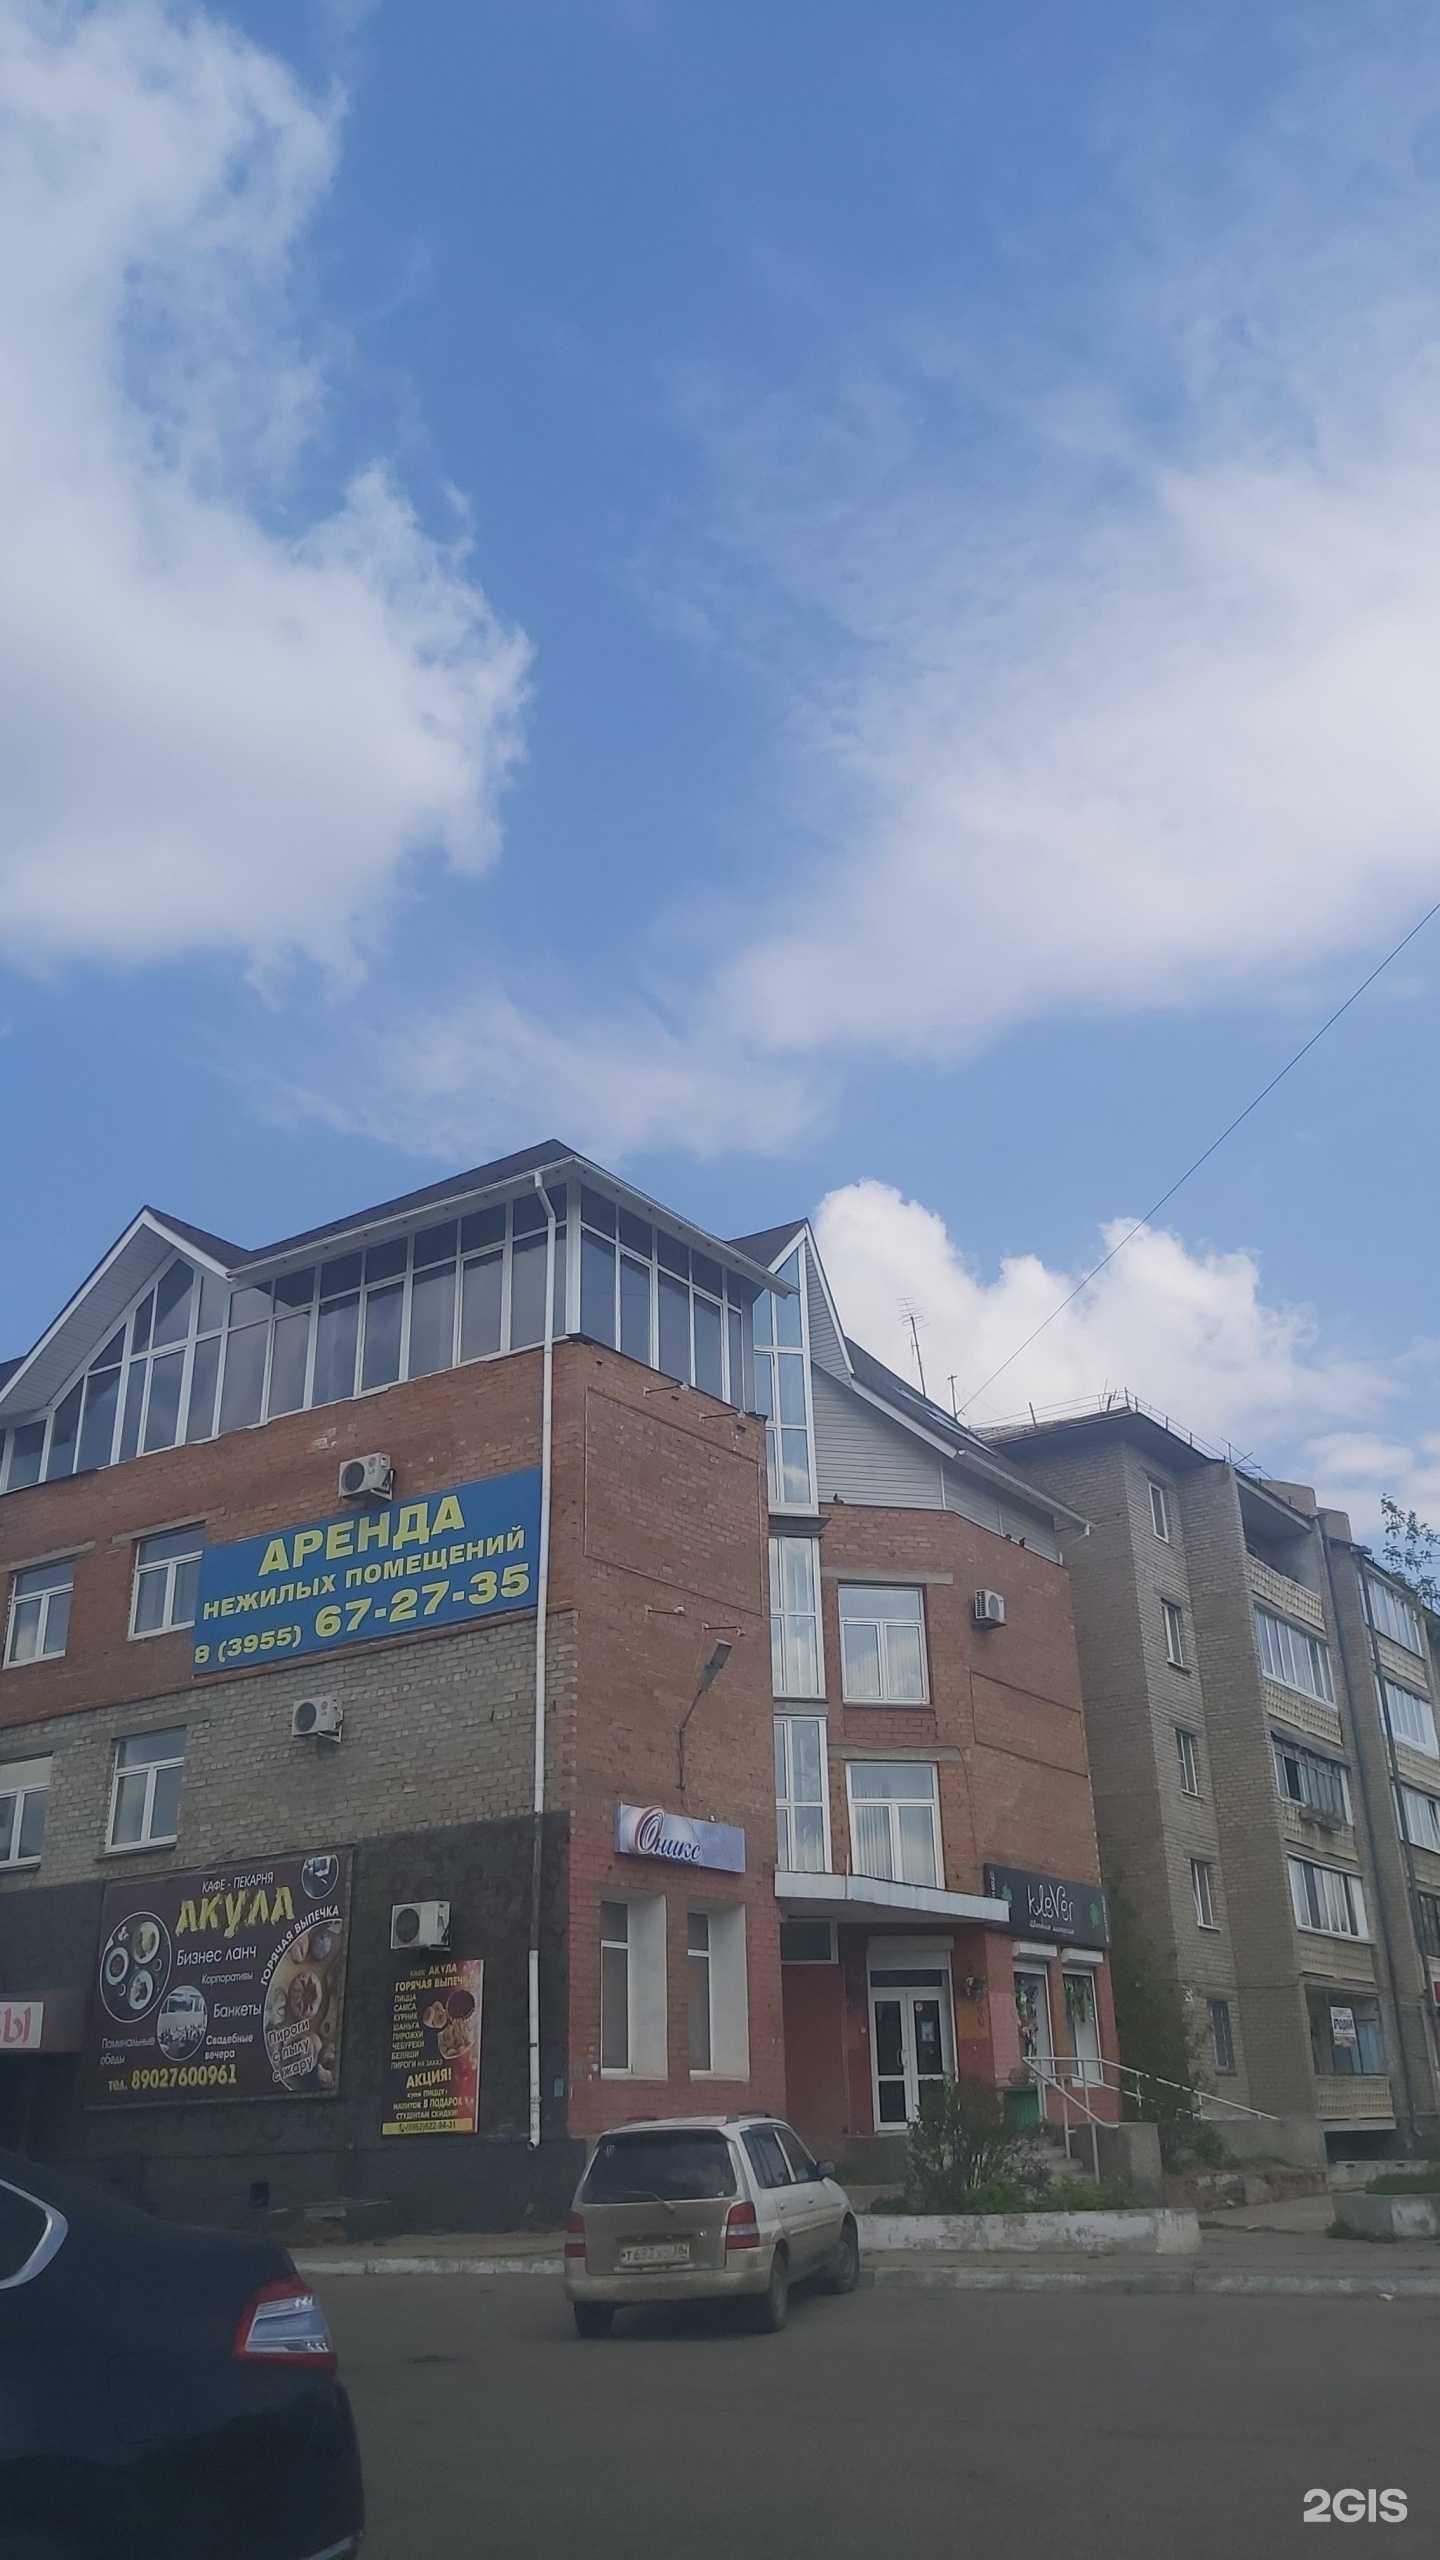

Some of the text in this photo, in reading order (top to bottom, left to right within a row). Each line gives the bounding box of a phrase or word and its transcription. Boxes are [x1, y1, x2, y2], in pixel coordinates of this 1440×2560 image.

[258, 1495, 465, 1576] АРЕНДА
[203, 1525, 526, 1620] НЕЖИЛЫХ ПОМЕЩЕНИЙ
[194, 1563, 530, 1664] 8 (3955) 67-27-35
[635, 1805, 702, 1861] Оникс
[202, 1878, 226, 1893] КАФЕ
[233, 1872, 274, 1889] ПЕКАРНЯ
[175, 1886, 295, 1939] АКУЛА
[176, 1946, 257, 1966] Бизнес ланч
[260, 1905, 340, 1986] ГОРЯЧАЯ ВЫПЕЧКА
[428, 1962, 457, 1976] АКУЛА
[395, 1979, 433, 1992] ГОРЯЧАЯ
[213, 2002, 263, 2019] Банкеты
[268, 2019, 310, 2046] Пироги
[204, 2050, 236, 2062] вечера
[282, 2056, 313, 2080] жару
[131, 2063, 238, 2090] 89027600961
[406, 2067, 452, 2088] АКЦИЯ!
[429, 2096, 463, 2109] ПОДАРОК
